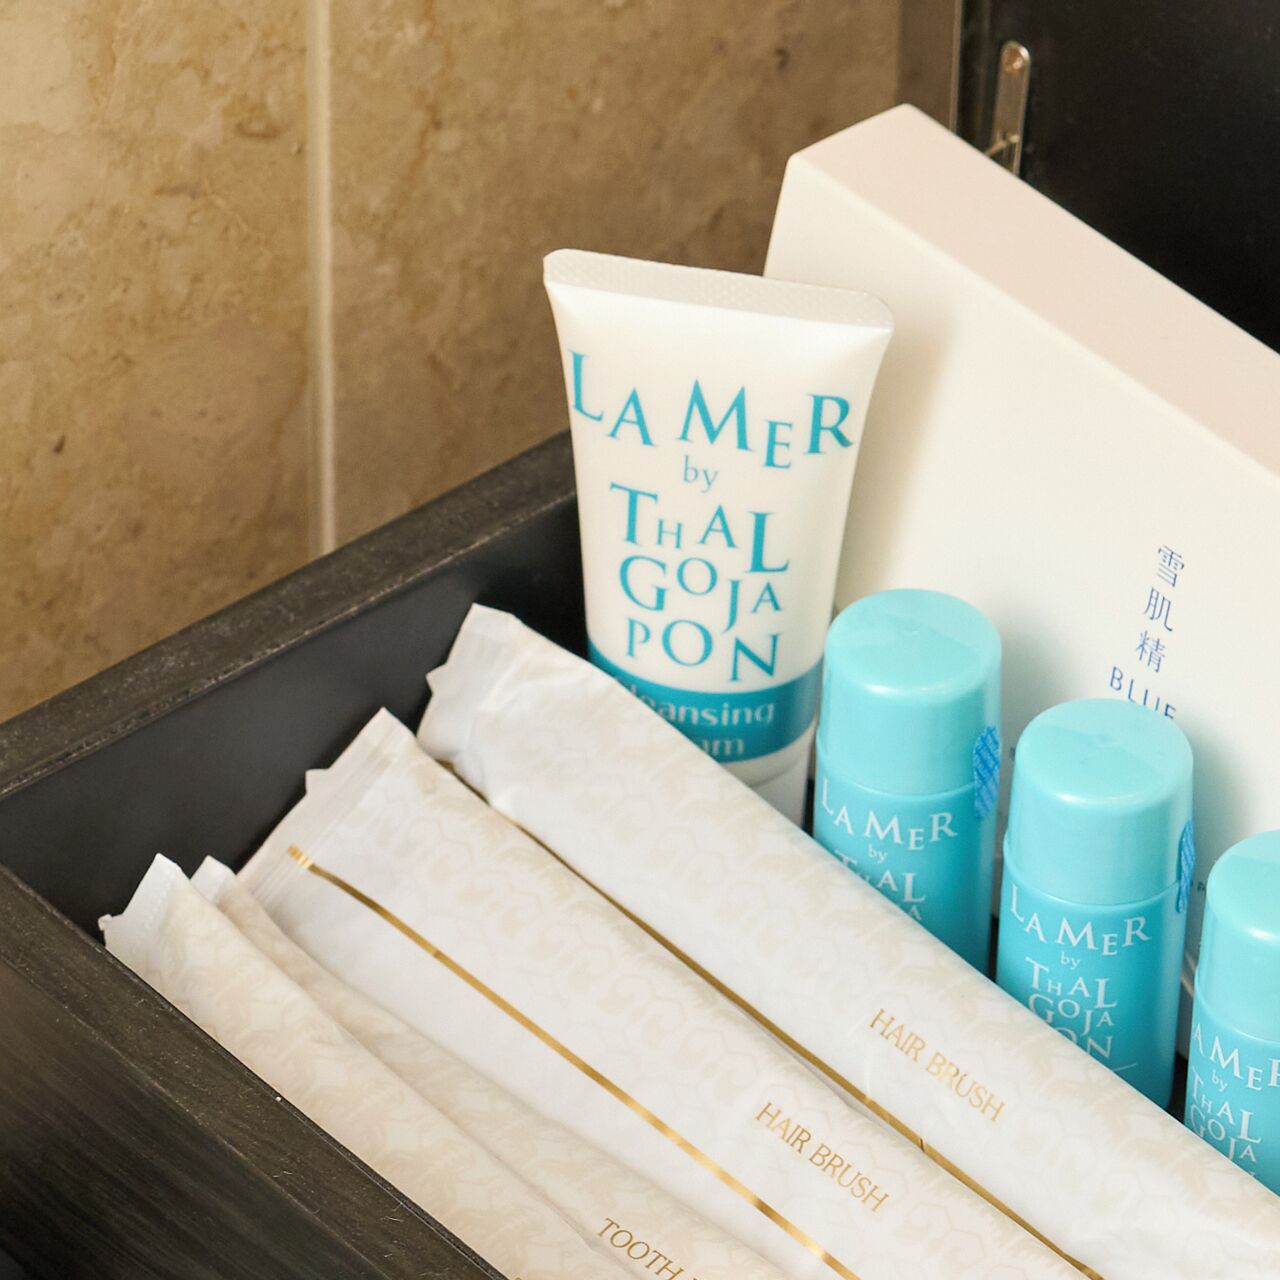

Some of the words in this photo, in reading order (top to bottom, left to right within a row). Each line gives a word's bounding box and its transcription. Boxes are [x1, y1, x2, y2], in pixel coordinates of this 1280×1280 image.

[568, 348, 656, 447] LA
[675, 378, 855, 470] MER
[682, 454, 720, 494] by
[1135, 544, 1186, 674] 雪肌精
[625, 618, 784, 684] PON
[631, 684, 776, 726] ansing
[821, 777, 855, 836] LA
[863, 809, 959, 851] MER
[867, 844, 888, 864] by
[1010, 883, 1048, 943] LA
[1054, 916, 1152, 957] MER
[1060, 951, 1082, 970] by
[867, 1007, 927, 1064] HAIR
[924, 1050, 1007, 1124] BRUSH
[1211, 1068, 1229, 1093] by
[754, 1101, 812, 1156] HAIR
[808, 1142, 891, 1214] BRUSH
